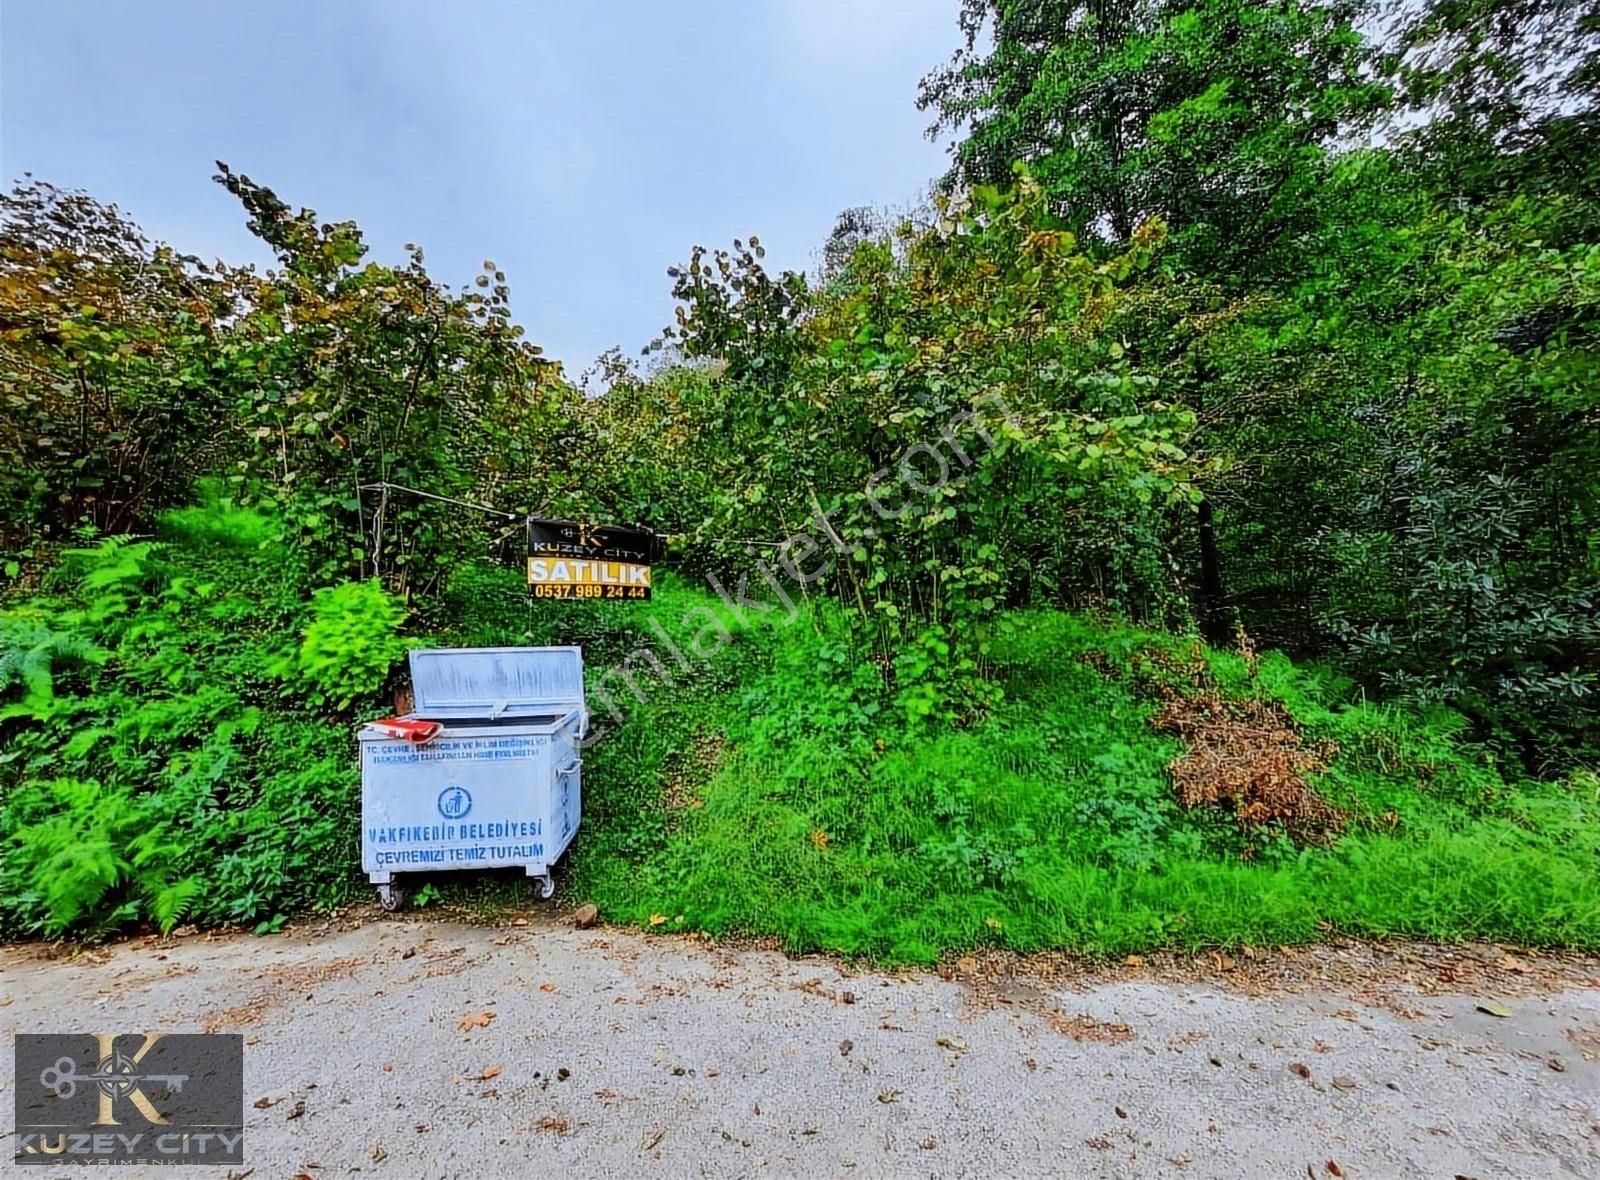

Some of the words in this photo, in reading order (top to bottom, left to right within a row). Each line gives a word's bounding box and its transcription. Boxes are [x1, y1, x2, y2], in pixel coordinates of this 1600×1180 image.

[533, 542, 598, 555] KUZEY
[530, 558, 650, 585] SATILIK
[535, 584, 571, 599] 0537
[575, 585, 603, 599] 989
[606, 586, 624, 598] 24
[628, 587, 646, 598] 44
[460, 818, 543, 838] BELEDİYESİ
[375, 846, 445, 868] ÇEVREMİZİ
[449, 843, 487, 862] TEMİZ
[490, 843, 544, 859] TUTALIM
